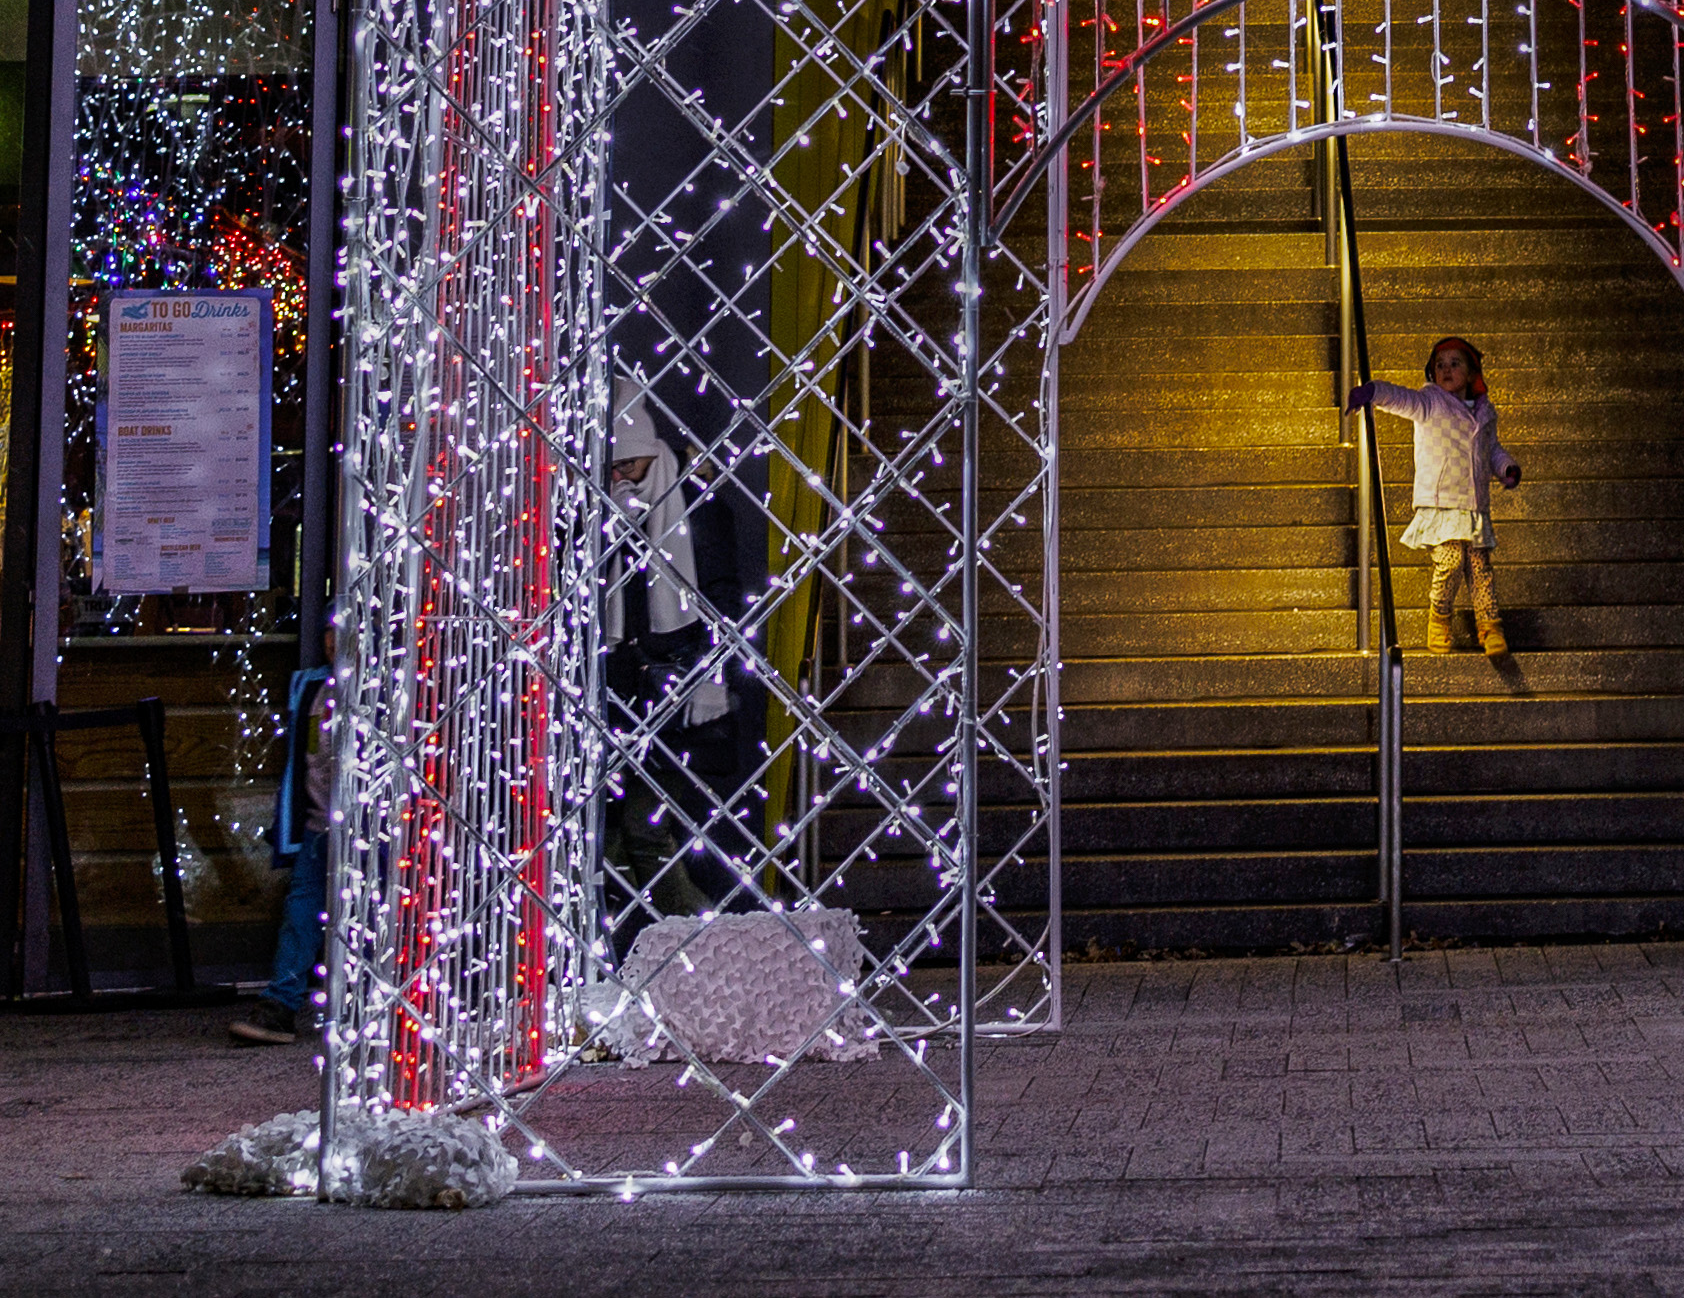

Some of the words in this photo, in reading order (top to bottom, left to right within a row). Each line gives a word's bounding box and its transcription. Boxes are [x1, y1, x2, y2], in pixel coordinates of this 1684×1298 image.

[151, 301, 169, 319] TO
[172, 301, 191, 319] GO
[190, 300, 251, 319] Drinks
[119, 322, 173, 333] MARGARITAS
[118, 425, 140, 437] BOAT
[141, 424, 172, 436] DRINKS
